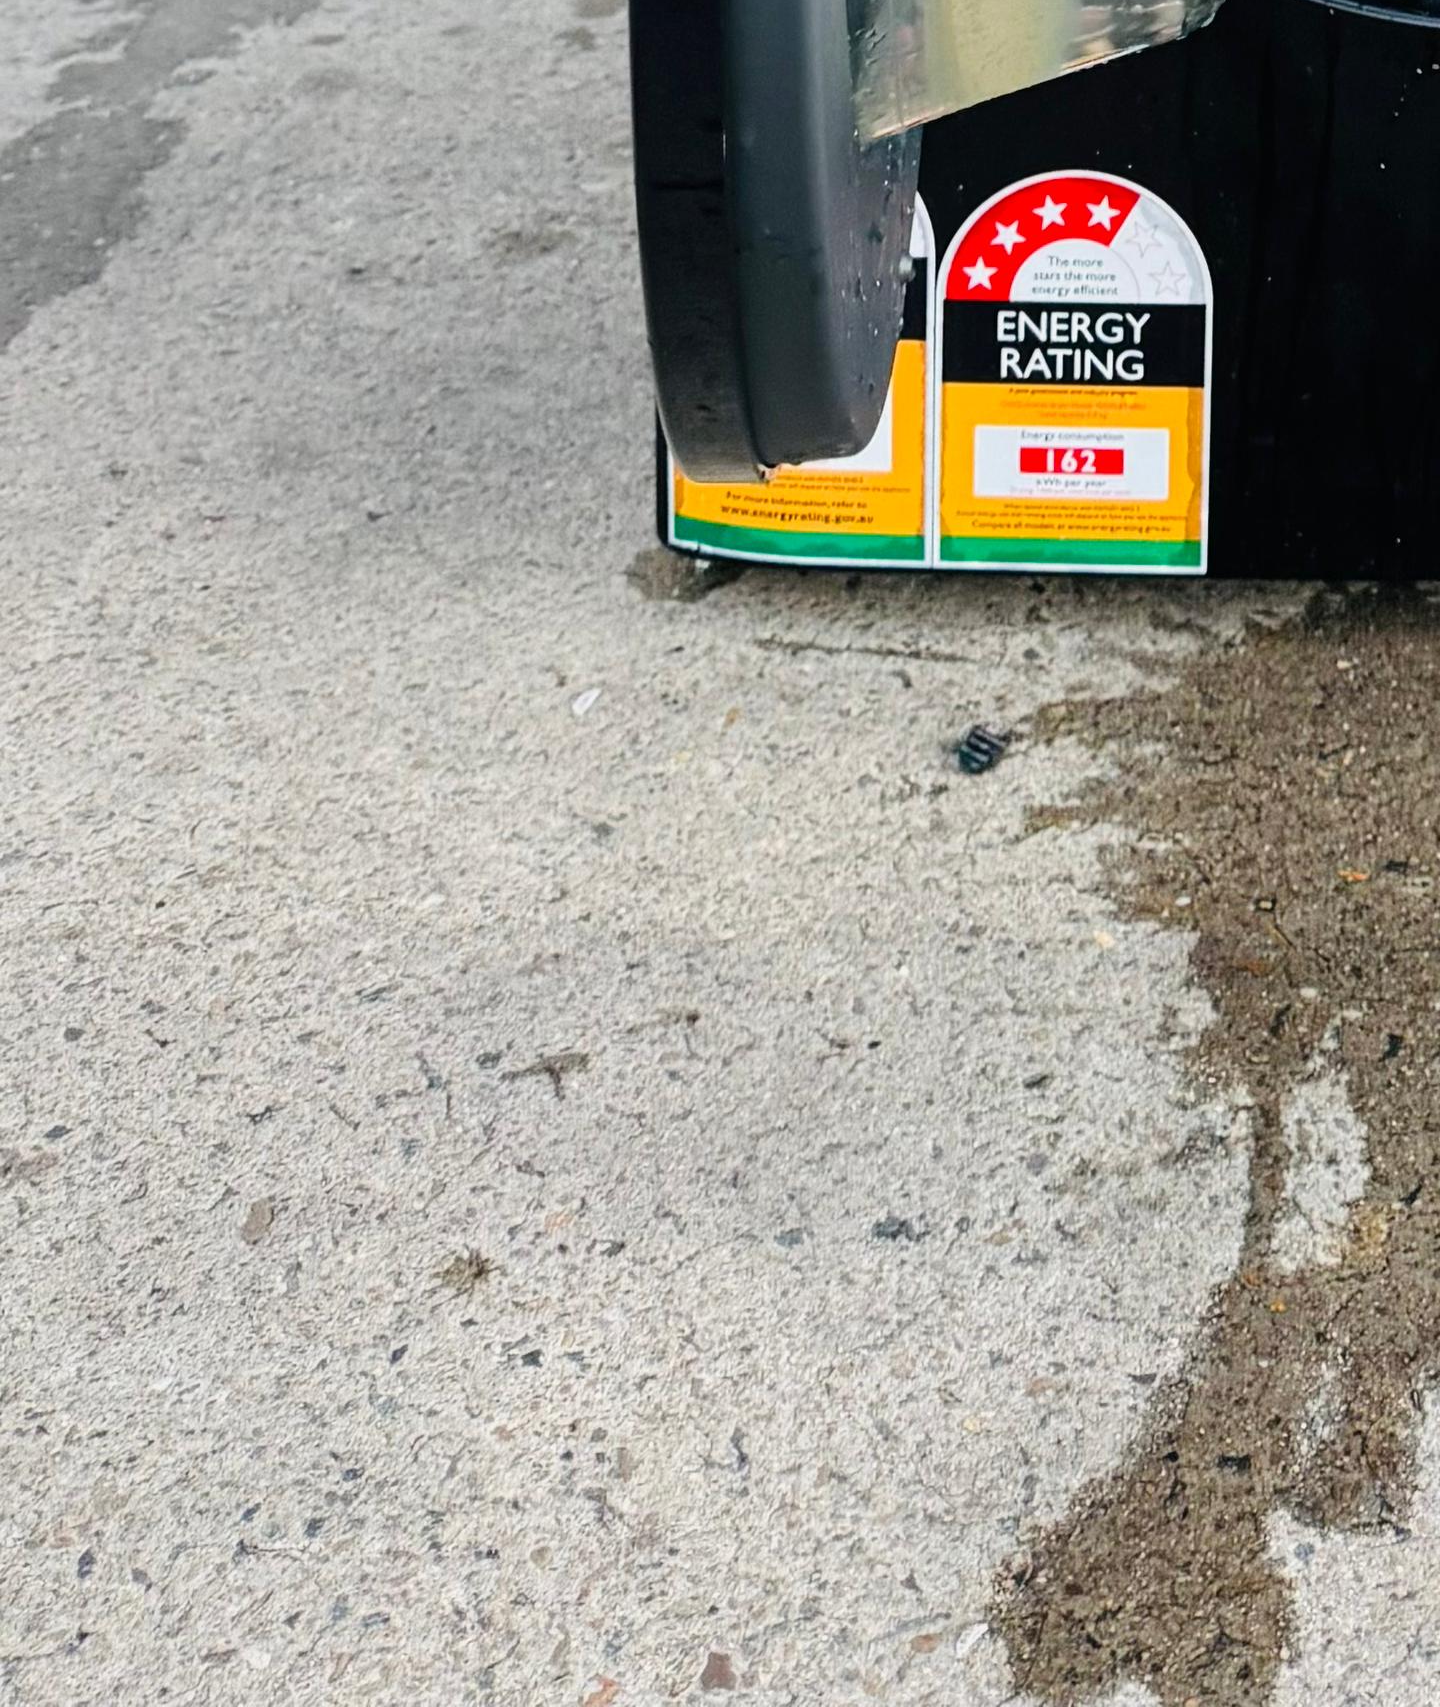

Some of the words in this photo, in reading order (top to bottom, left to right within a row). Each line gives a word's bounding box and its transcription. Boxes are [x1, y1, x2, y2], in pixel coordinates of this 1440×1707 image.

[1049, 255, 1069, 267] The
[1072, 258, 1104, 267] more
[1034, 272, 1061, 281] stars
[1064, 270, 1084, 281] the
[1085, 273, 1116, 281] more
[1032, 286, 1071, 297] energy
[997, 310, 1150, 344] ENERGY
[1000, 347, 1144, 381] RATING
[1046, 448, 1096, 473] 162
